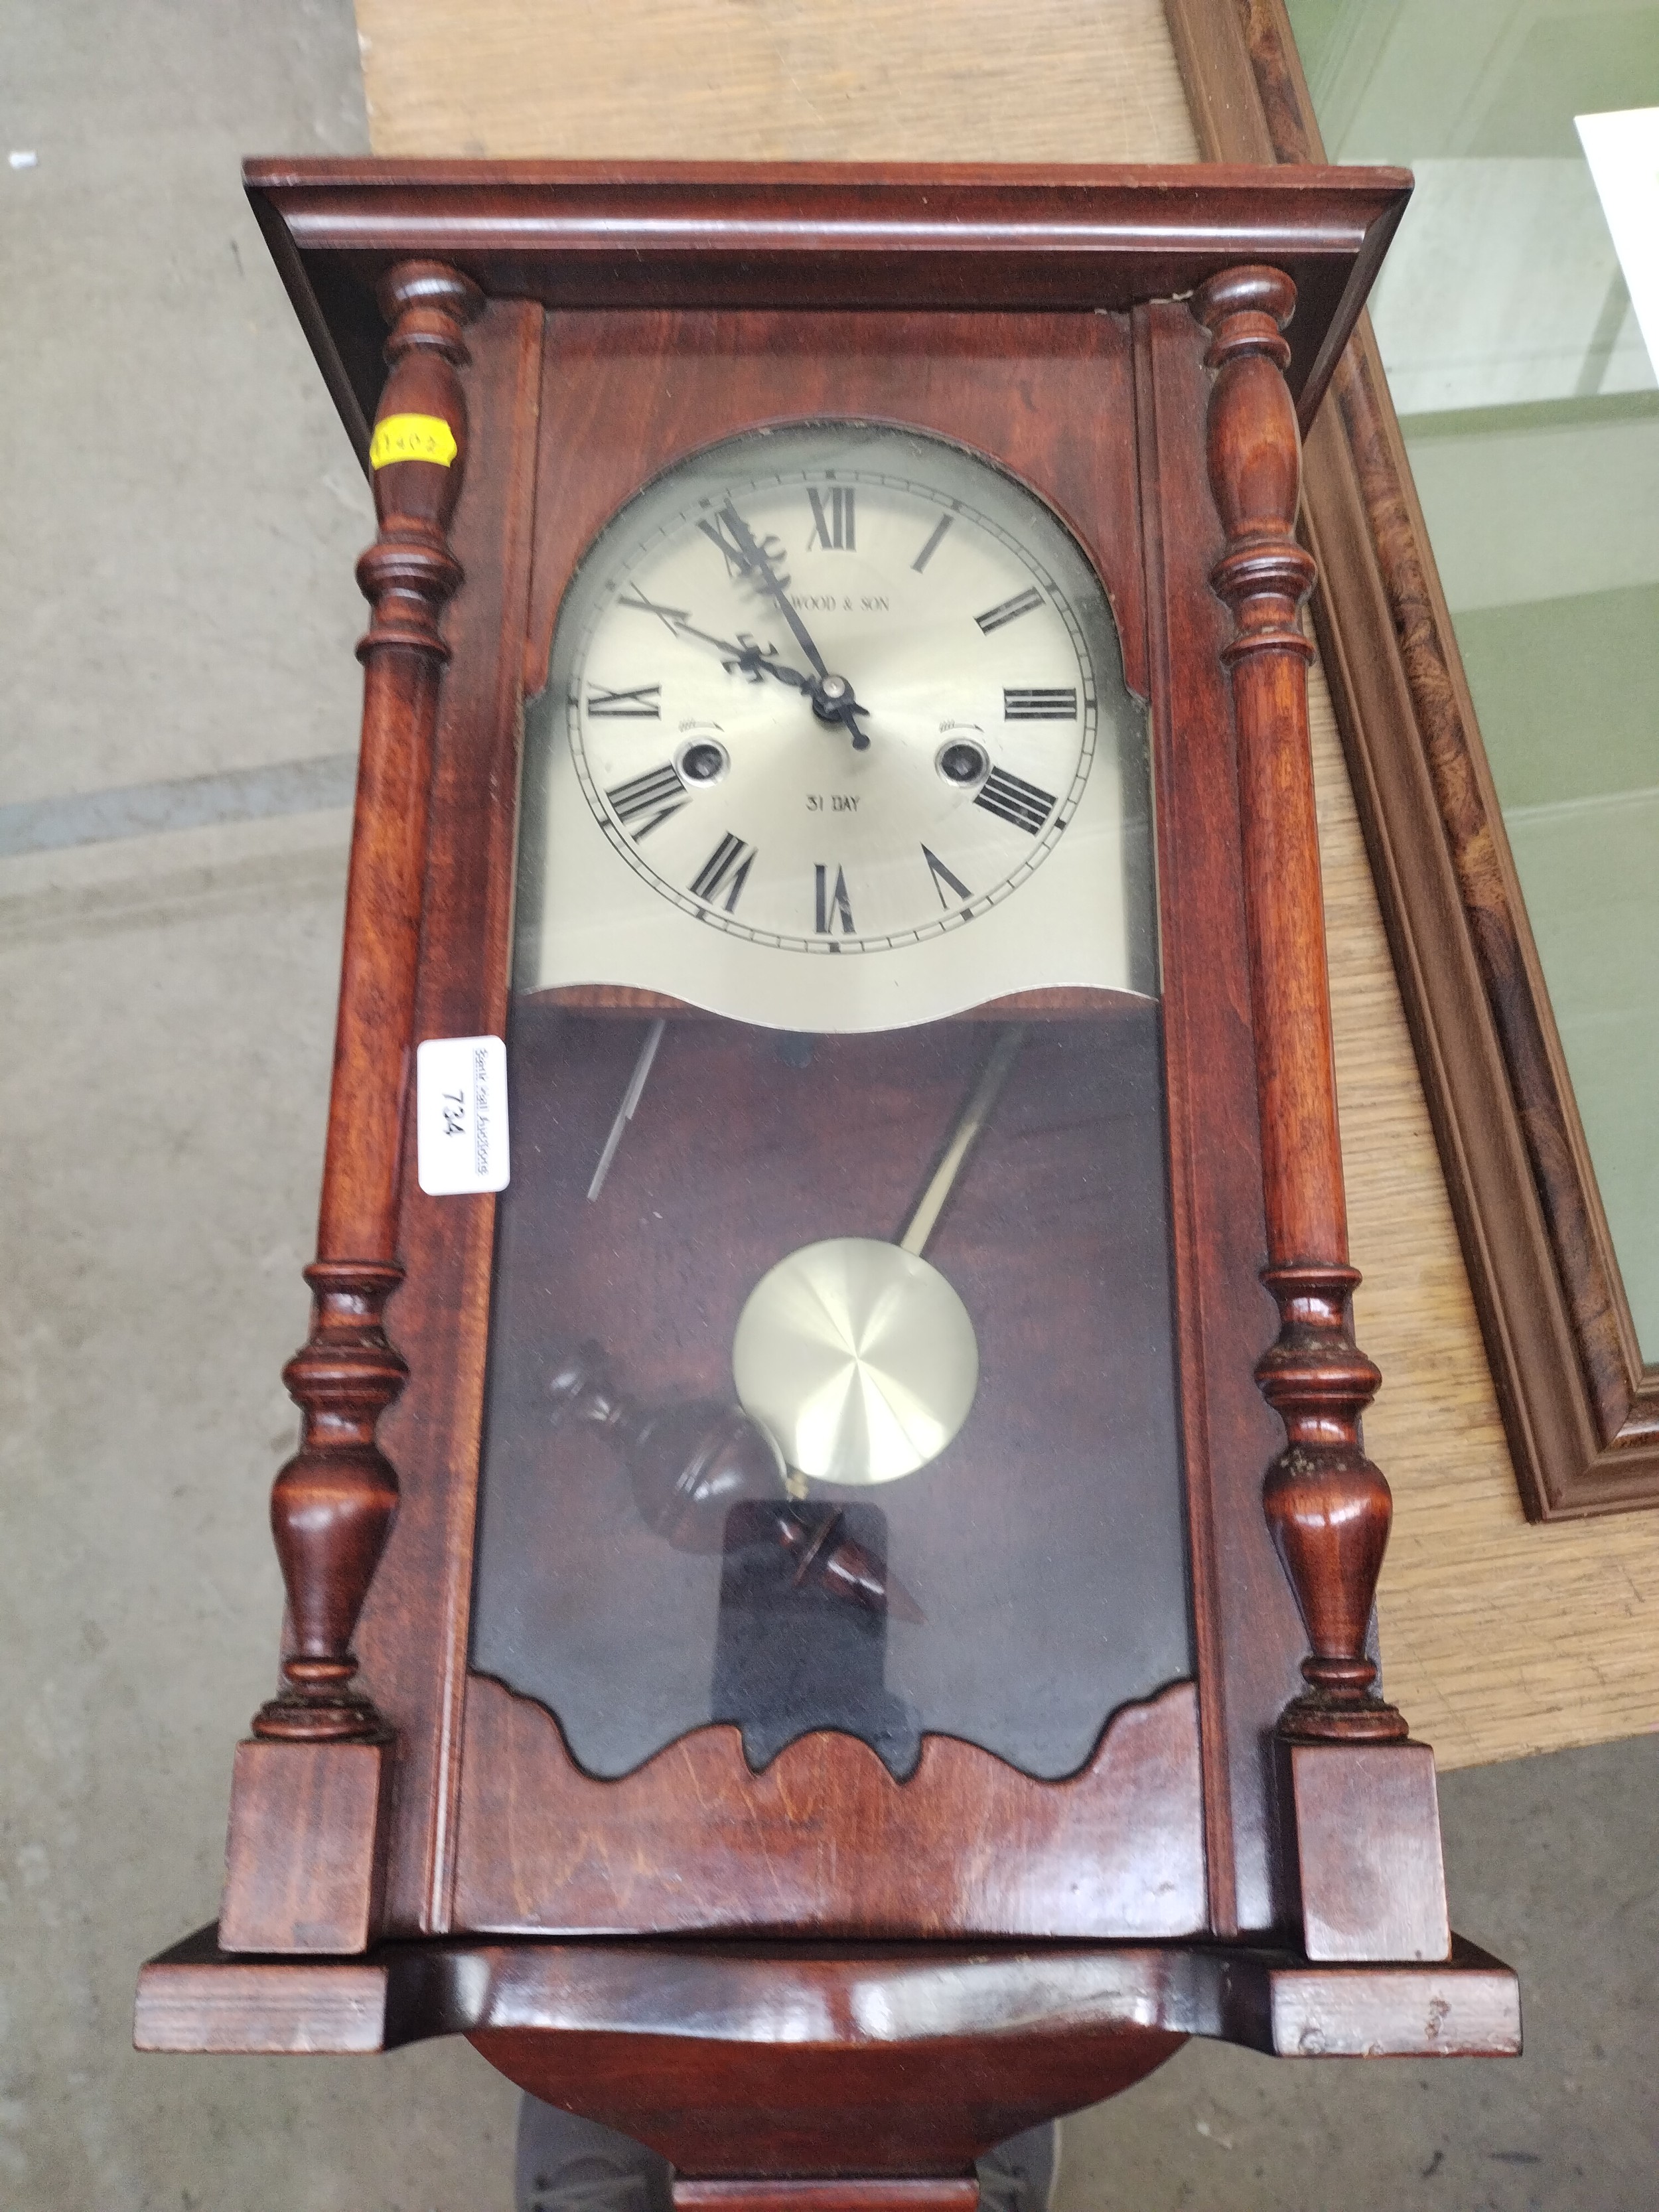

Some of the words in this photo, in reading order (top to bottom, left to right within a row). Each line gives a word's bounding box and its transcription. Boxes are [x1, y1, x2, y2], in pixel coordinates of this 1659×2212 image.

[805, 487, 856, 552] XII
[910, 512, 955, 573] I
[617, 579, 691, 638] X
[790, 595, 837, 612] WOOD
[843, 595, 853, 612] &
[861, 595, 889, 612] SON
[973, 586, 1046, 636] II
[587, 681, 662, 720] IX
[1003, 687, 1077, 722] III
[604, 760, 693, 844] VIII
[806, 794, 824, 812] 31
[830, 794, 861, 812] DAY
[973, 764, 1059, 838] IIII
[686, 831, 758, 914] VII
[814, 863, 857, 934] VI
[920, 841, 974, 911] V
